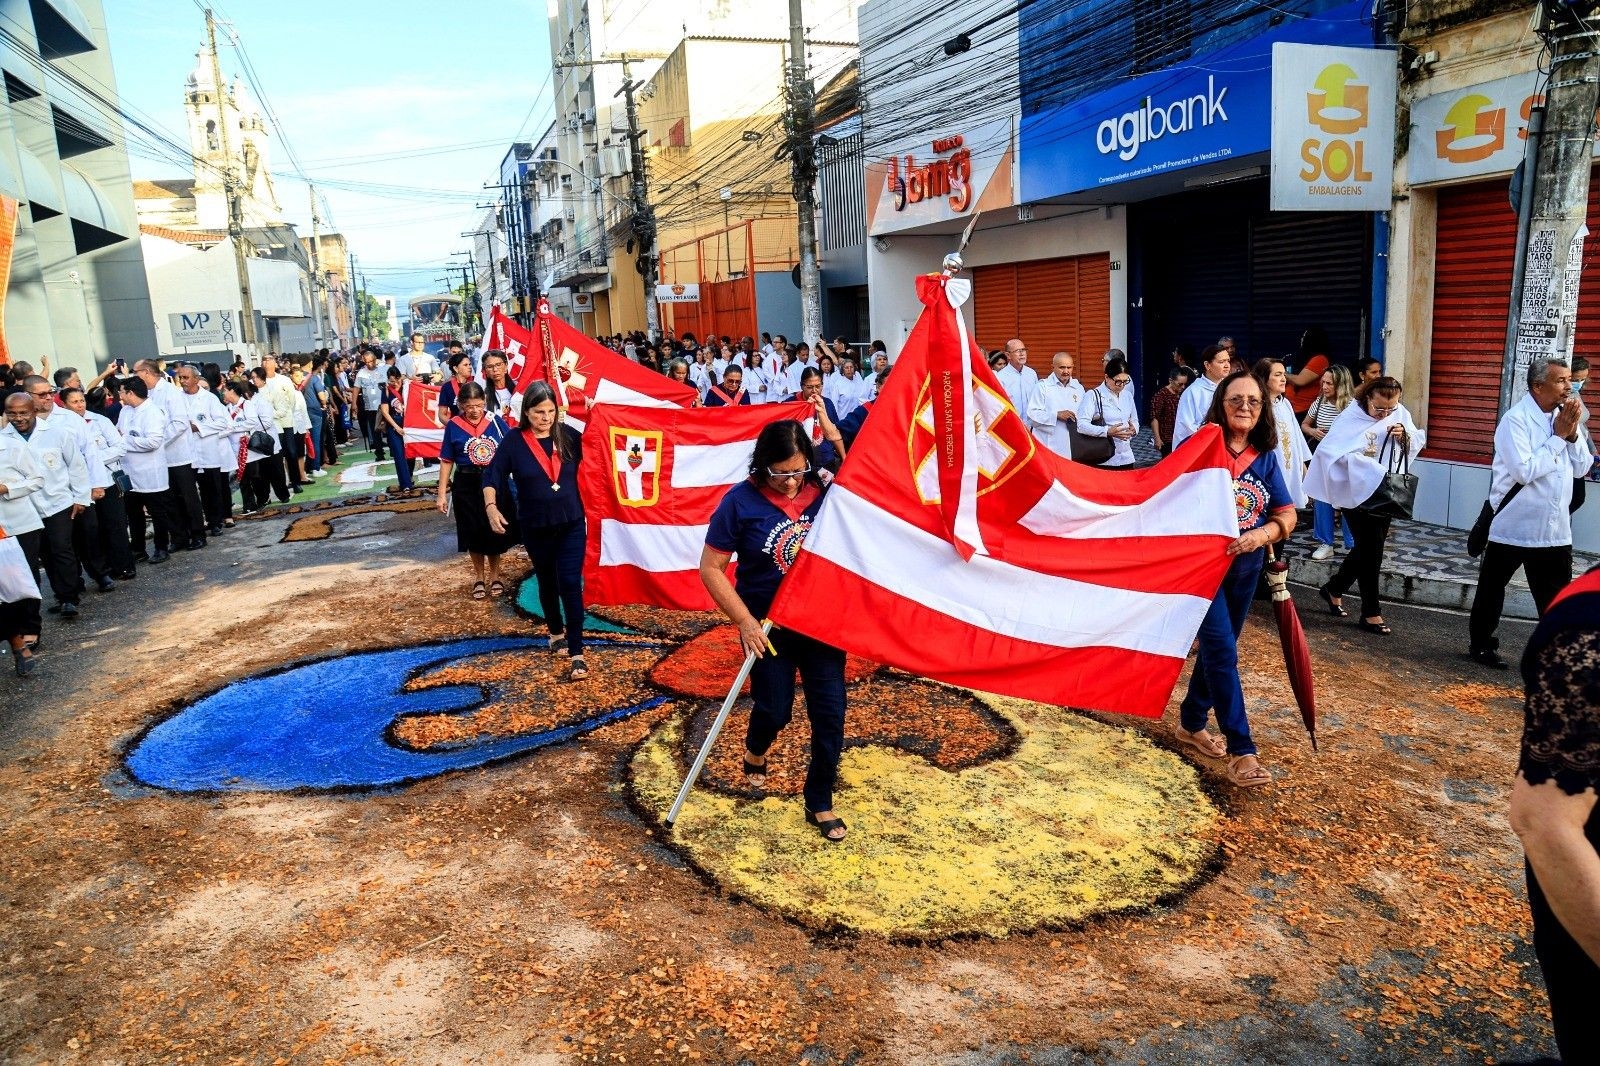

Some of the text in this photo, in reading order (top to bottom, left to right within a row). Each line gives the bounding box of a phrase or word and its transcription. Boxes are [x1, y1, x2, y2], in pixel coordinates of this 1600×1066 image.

[1096, 75, 1228, 161] agibank
[1167, 158, 1191, 168] Promotora
[1199, 152, 1217, 161] Vendas
[1218, 148, 1232, 157] LTDA
[1299, 138, 1372, 182] SOL
[1308, 185, 1362, 196] EMBALAGENS
[181, 312, 210, 330] MP
[943, 370, 954, 468] PARÓQUIA SANTA TEREZINHA
